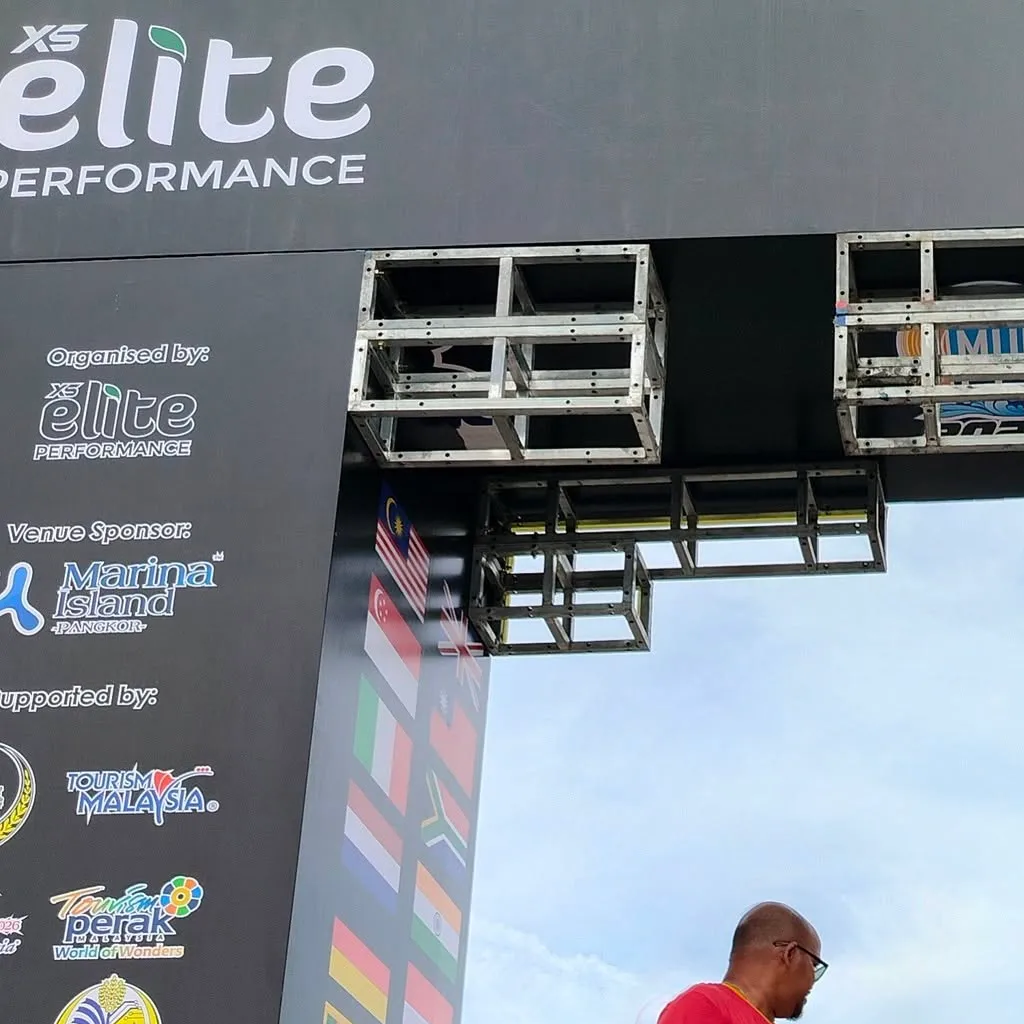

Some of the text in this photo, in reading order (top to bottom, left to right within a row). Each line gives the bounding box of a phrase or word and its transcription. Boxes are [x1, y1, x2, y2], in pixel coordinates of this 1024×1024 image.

[10, 23, 88, 55] XS
[0, 19, 375, 152] elite
[47, 344, 210, 370] Organised by:
[45, 382, 84, 398] XS
[39, 380, 197, 441] elite
[33, 440, 192, 460] PERFORMANCE
[7, 521, 192, 544] Venue Sponsor:
[62, 556, 218, 591] Marina
[52, 586, 176, 619] Island
[0, 684, 158, 712] upported by:
[66, 770, 154, 793] TOURISM
[76, 787, 205, 826] MALAYSIA
[50, 883, 160, 920] Tourism
[63, 908, 176, 943] perak
[53, 943, 184, 960] World of Wonders
